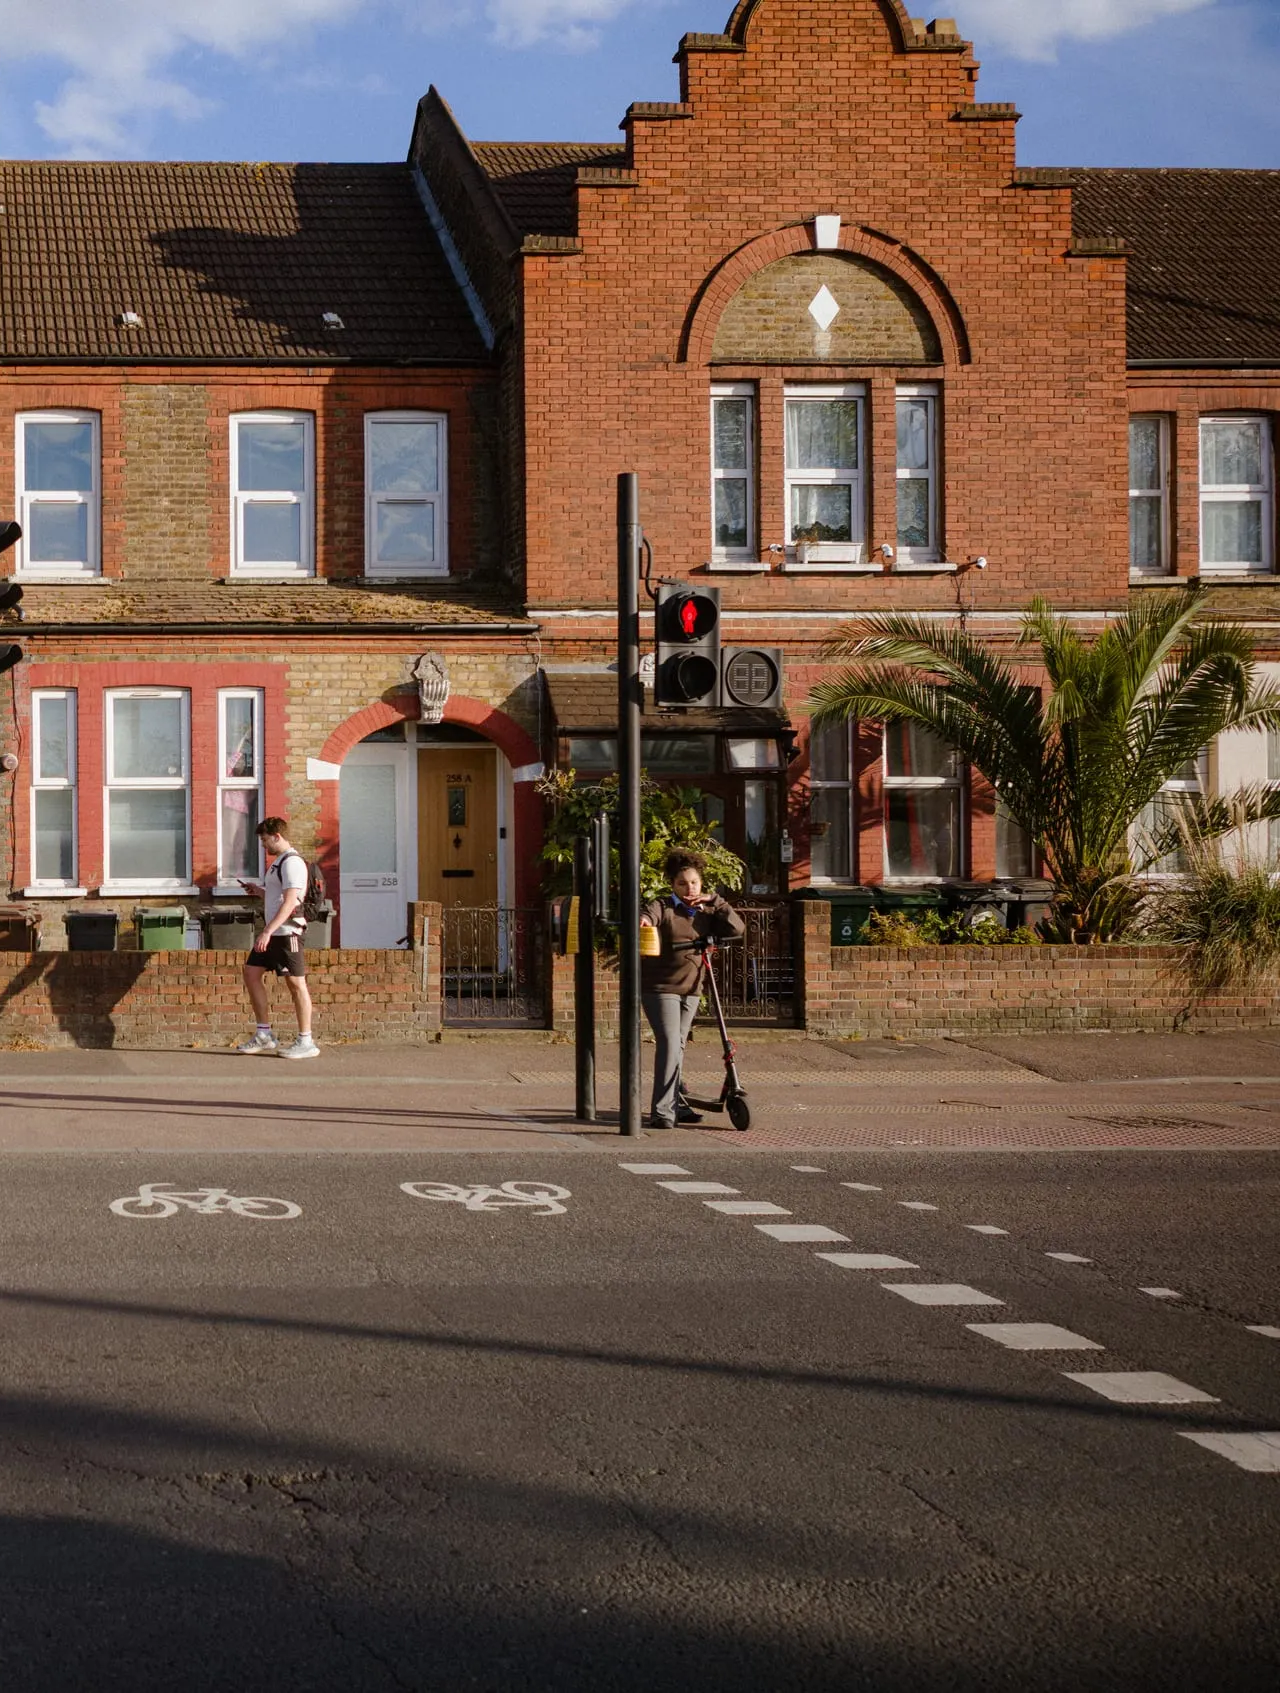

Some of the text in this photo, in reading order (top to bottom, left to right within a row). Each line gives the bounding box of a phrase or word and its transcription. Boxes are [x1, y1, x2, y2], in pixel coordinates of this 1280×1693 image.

[446, 774, 472, 783] 258 A
[381, 877, 398, 886] 258
